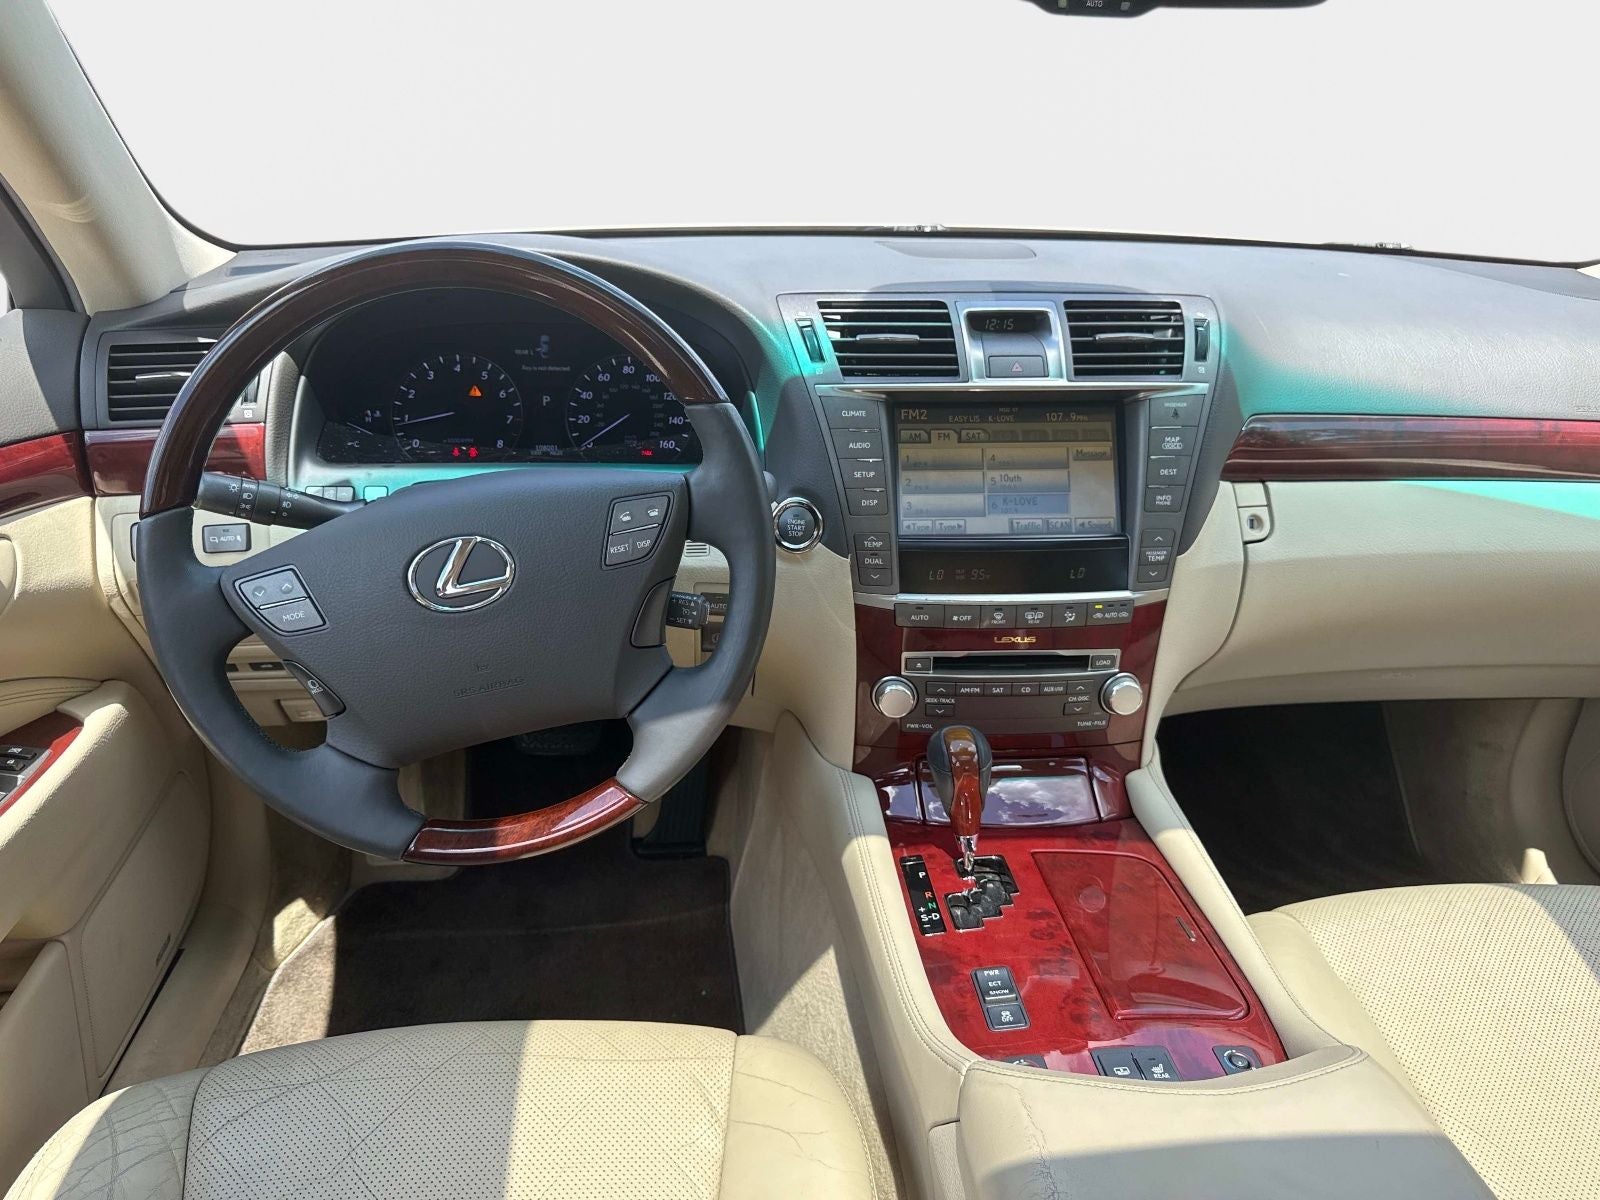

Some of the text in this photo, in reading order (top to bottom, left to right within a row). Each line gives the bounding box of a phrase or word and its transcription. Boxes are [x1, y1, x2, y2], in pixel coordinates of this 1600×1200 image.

[1086, 0, 1103, 8] AUTO
[984, 318, 1015, 330] 12:15
[453, 363, 461, 373] 4
[622, 365, 635, 374] 80
[426, 371, 434, 380] 3
[481, 371, 489, 380] 5
[597, 373, 611, 382] 60
[408, 389, 416, 399] 2
[499, 389, 507, 399] 6
[580, 391, 593, 400] 40
[542, 395, 551, 406] P
[901, 409, 928, 420] FM2
[948, 415, 969, 423] EASY
[506, 415, 514, 424] 7
[577, 415, 590, 424] 20
[668, 416, 684, 425] 140
[908, 432, 921, 441] AM
[937, 432, 950, 441] FM
[966, 432, 981, 441] SAT
[412, 439, 420, 448] 0
[496, 439, 504, 448] 8
[659, 440, 675, 449] 160
[1159, 468, 1177, 476] DEST
[905, 478, 912, 487] 2
[990, 477, 997, 486] 5
[906, 501, 912, 511] 3
[1016, 521, 1041, 529] Traffic
[1049, 521, 1070, 530] SCAN
[610, 543, 629, 554] RESET
[636, 539, 651, 549] DISP
[864, 557, 884, 565] DUAL
[282, 610, 305, 622] MODE
[918, 871, 926, 880] P
[927, 901, 937, 909] N
[983, 969, 1000, 977] PWR
